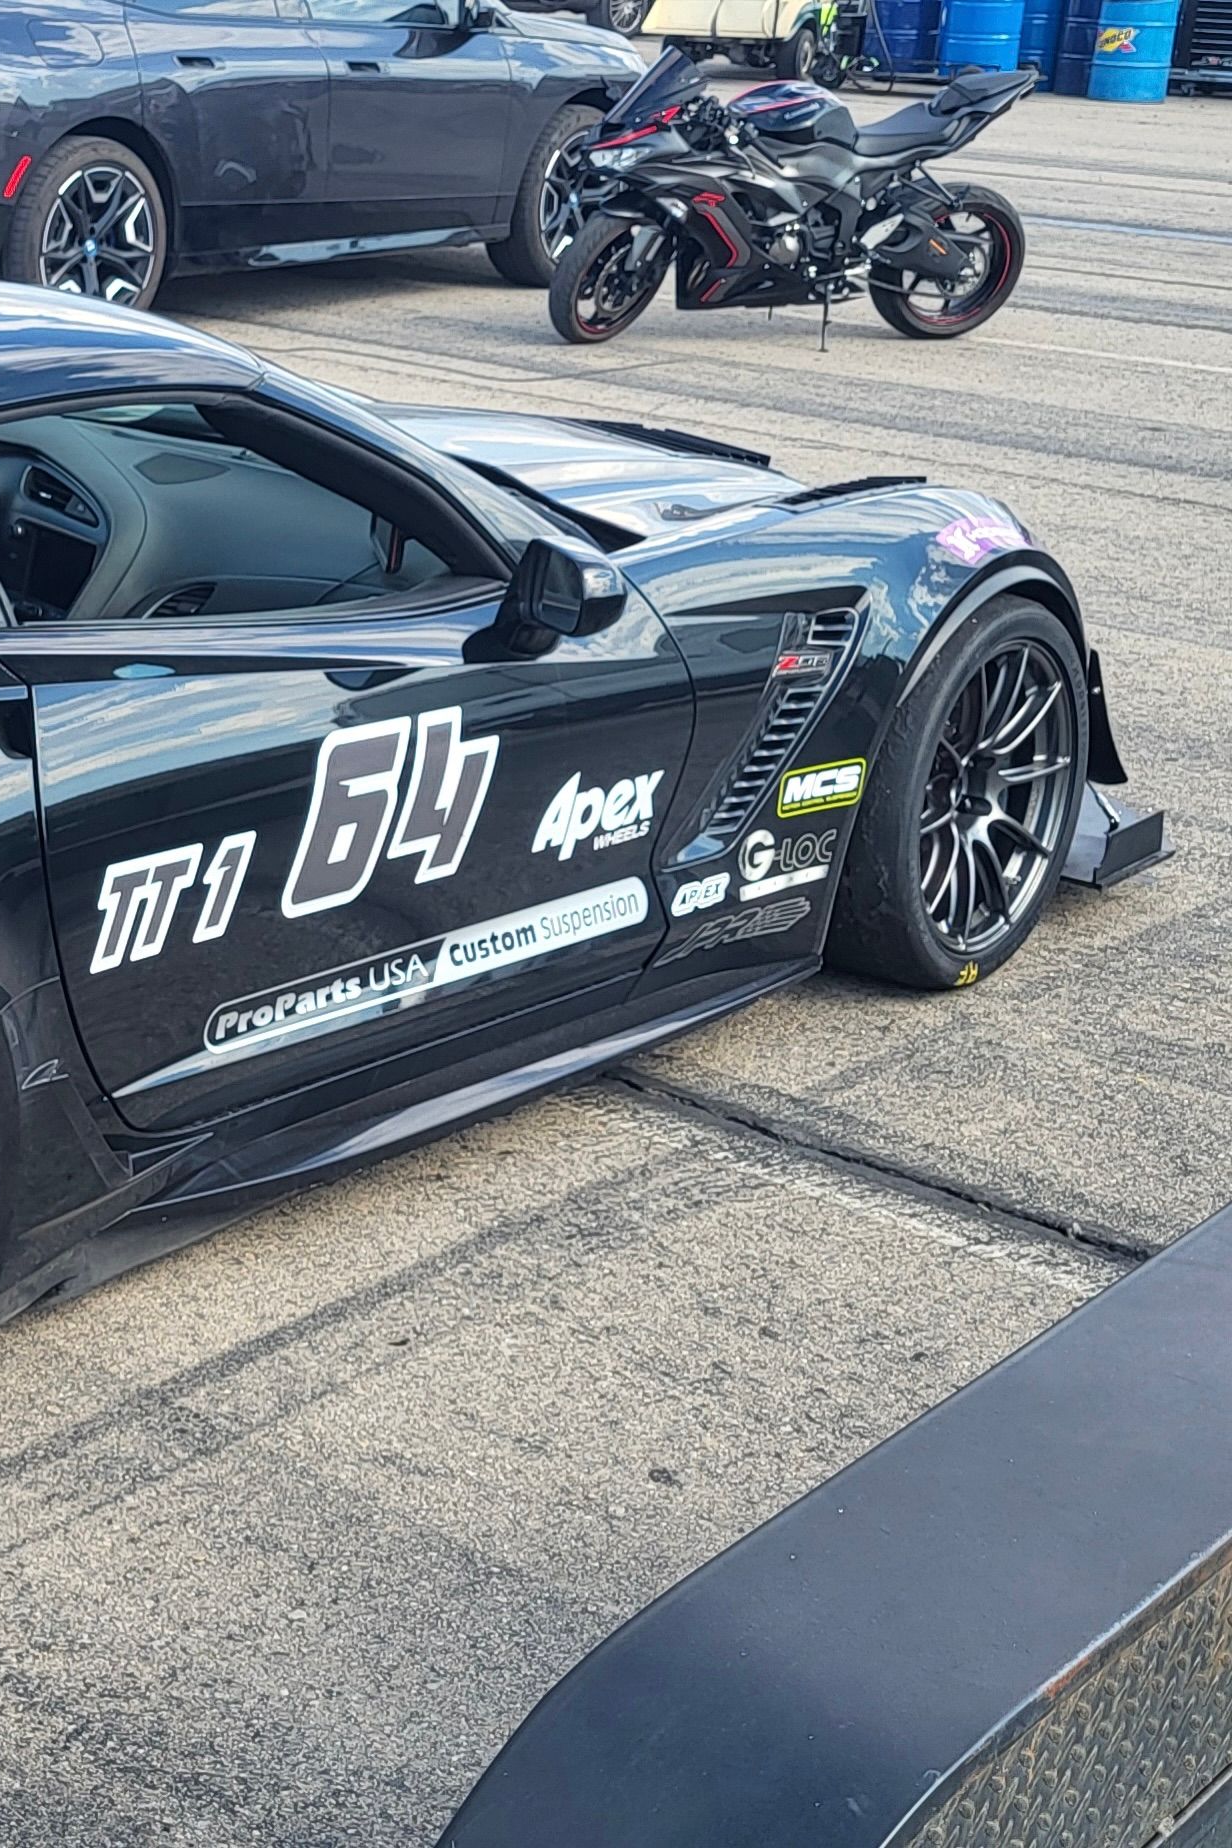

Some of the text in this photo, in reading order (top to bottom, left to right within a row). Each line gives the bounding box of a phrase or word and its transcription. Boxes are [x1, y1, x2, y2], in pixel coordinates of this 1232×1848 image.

[281, 705, 500, 919] 64
[531, 769, 665, 861] Apex
[782, 764, 862, 805] MCS
[593, 820, 651, 851] WHEELS
[738, 828, 837, 881] G-LOC
[89, 830, 257, 975] TT 1
[215, 976, 362, 1040] ProParts
[369, 953, 429, 991] USA
[449, 924, 537, 966] Custom
[540, 893, 639, 940] Suspension
